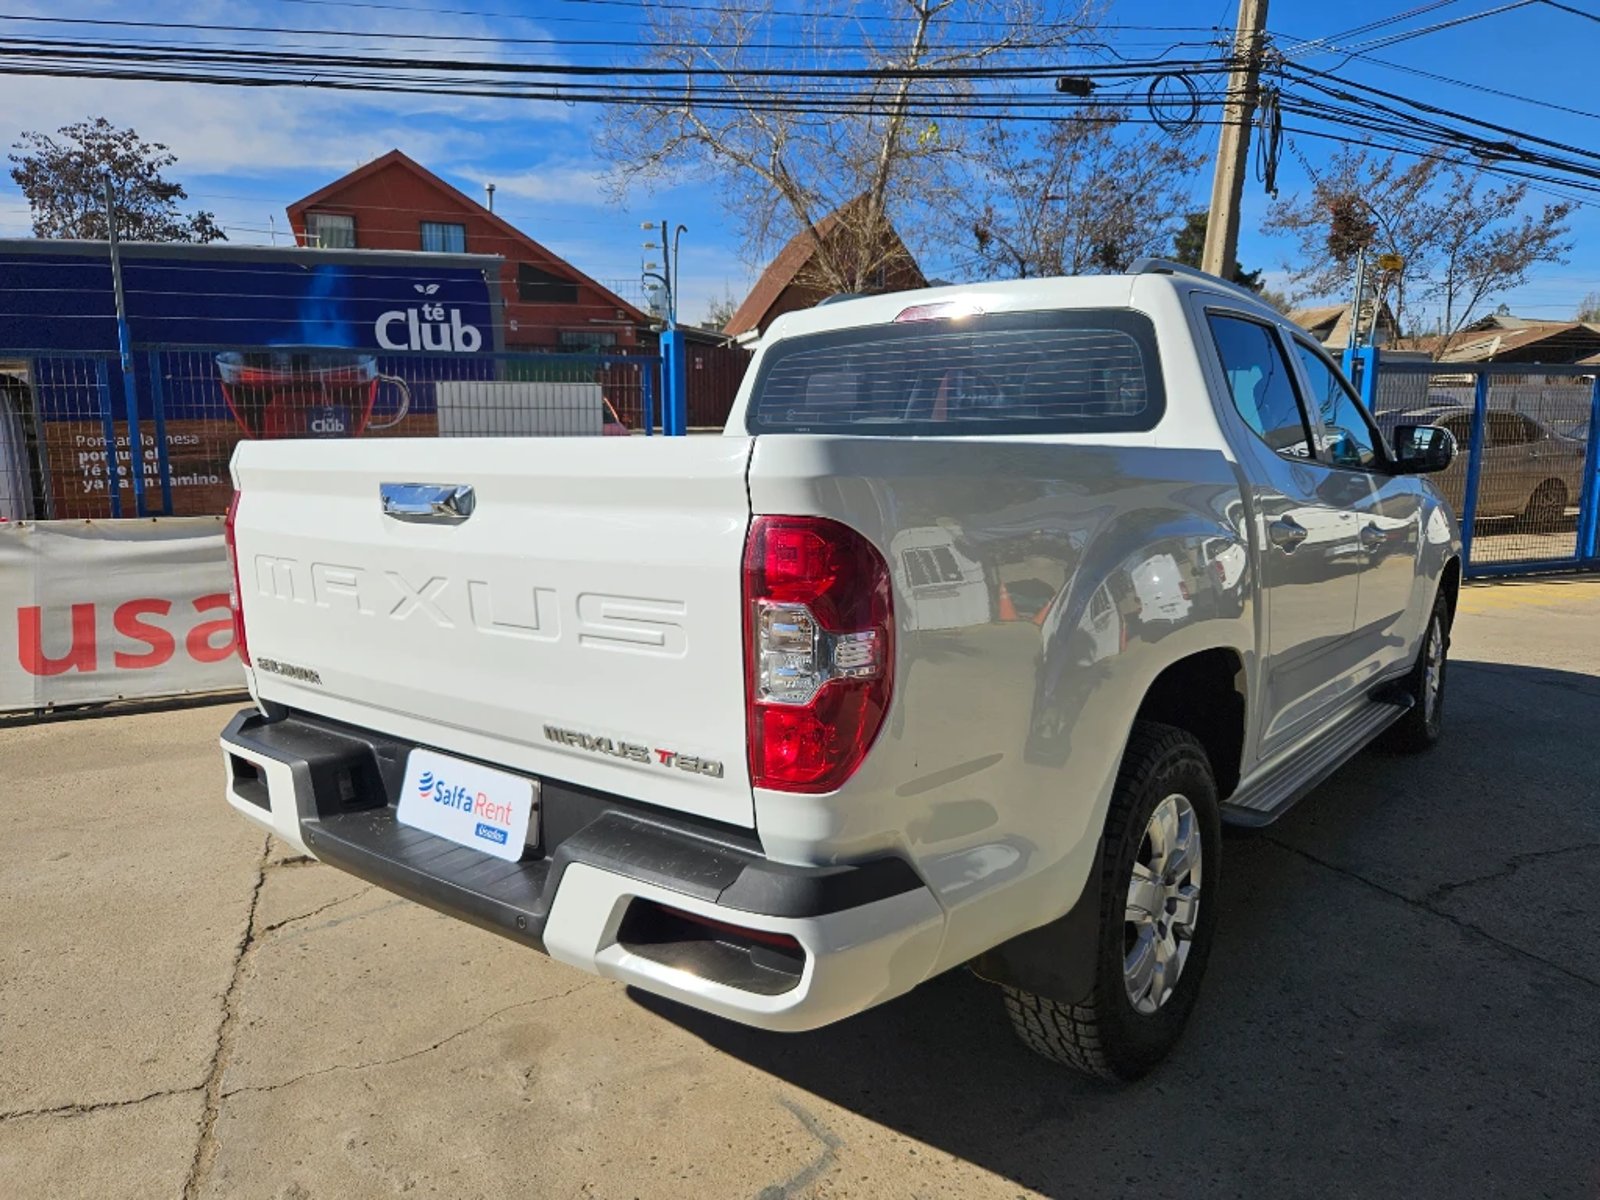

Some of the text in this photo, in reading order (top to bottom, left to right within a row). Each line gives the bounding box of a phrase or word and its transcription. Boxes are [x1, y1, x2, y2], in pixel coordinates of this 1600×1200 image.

[422, 302, 445, 321] té
[375, 308, 482, 353] Club
[76, 434, 130, 448] Ponan
[140, 432, 154, 446] la
[311, 418, 345, 432] Club
[82, 478, 103, 493] ya
[254, 554, 688, 659] MAXUS
[543, 724, 724, 779] MAXUS T60
[434, 780, 513, 826] SalfaRent
